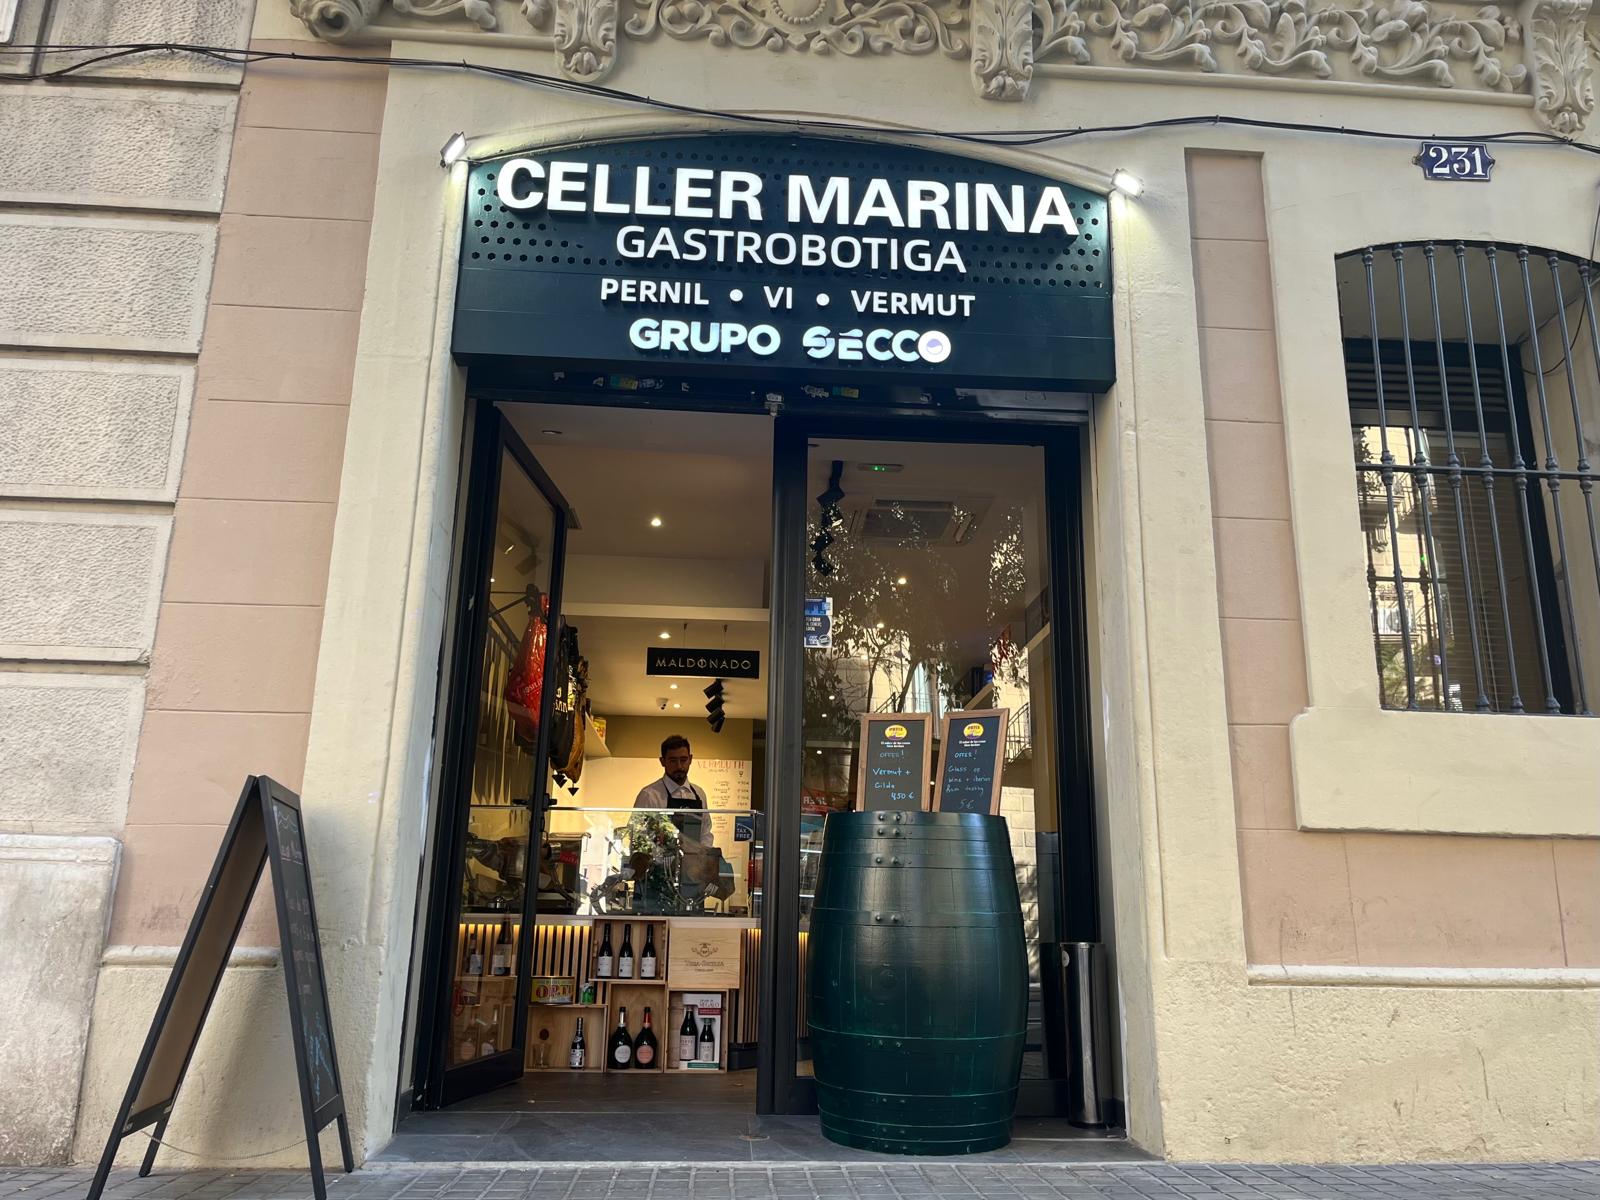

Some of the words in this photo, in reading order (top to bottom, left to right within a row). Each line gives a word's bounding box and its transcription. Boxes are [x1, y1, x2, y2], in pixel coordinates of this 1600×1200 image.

[1429, 146, 1485, 176] 231
[496, 158, 763, 221] CELLER
[787, 174, 1080, 236] MARINA
[615, 224, 967, 274] GASTROBOTIGA
[600, 277, 709, 307] PERNIL
[763, 285, 793, 310] VI
[850, 289, 977, 319] VERMUT
[629, 317, 781, 356] GRUPO
[655, 656, 752, 670] MALDONADO
